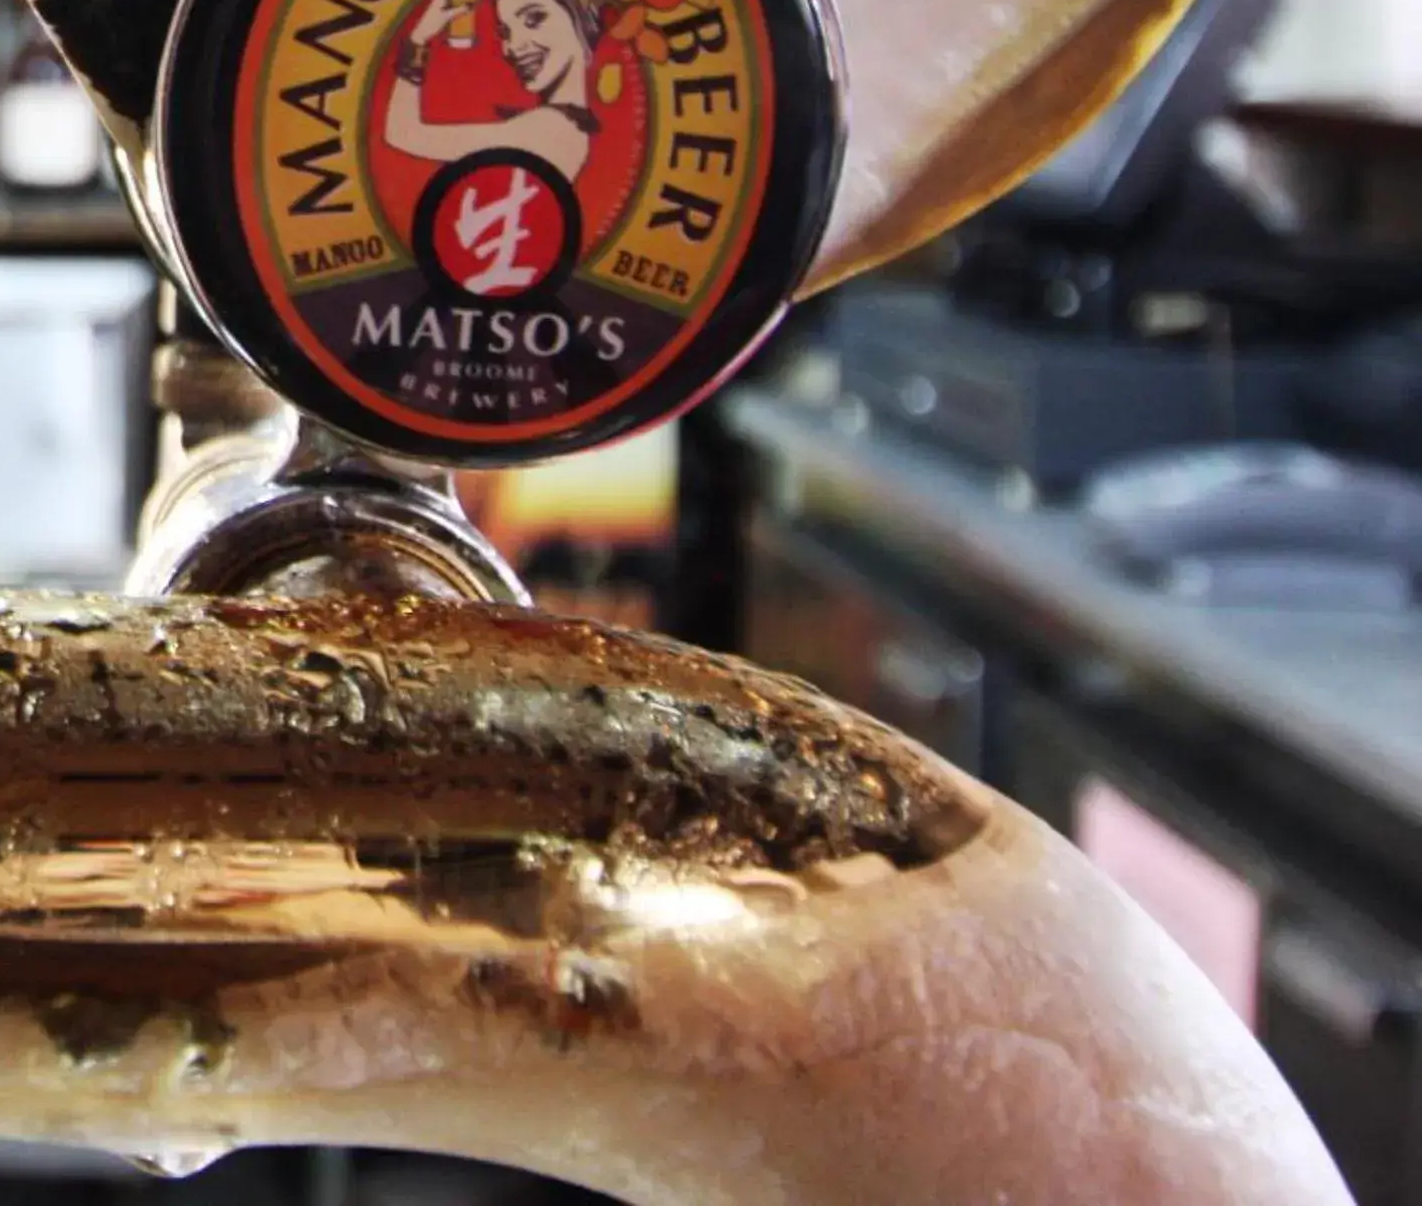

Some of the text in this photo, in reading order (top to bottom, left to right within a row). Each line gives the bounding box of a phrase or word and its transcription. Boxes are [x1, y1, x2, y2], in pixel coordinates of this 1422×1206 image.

[648, 6, 740, 242] BEER
[610, 249, 690, 296] BEER
[351, 301, 627, 362] MATSO'S
